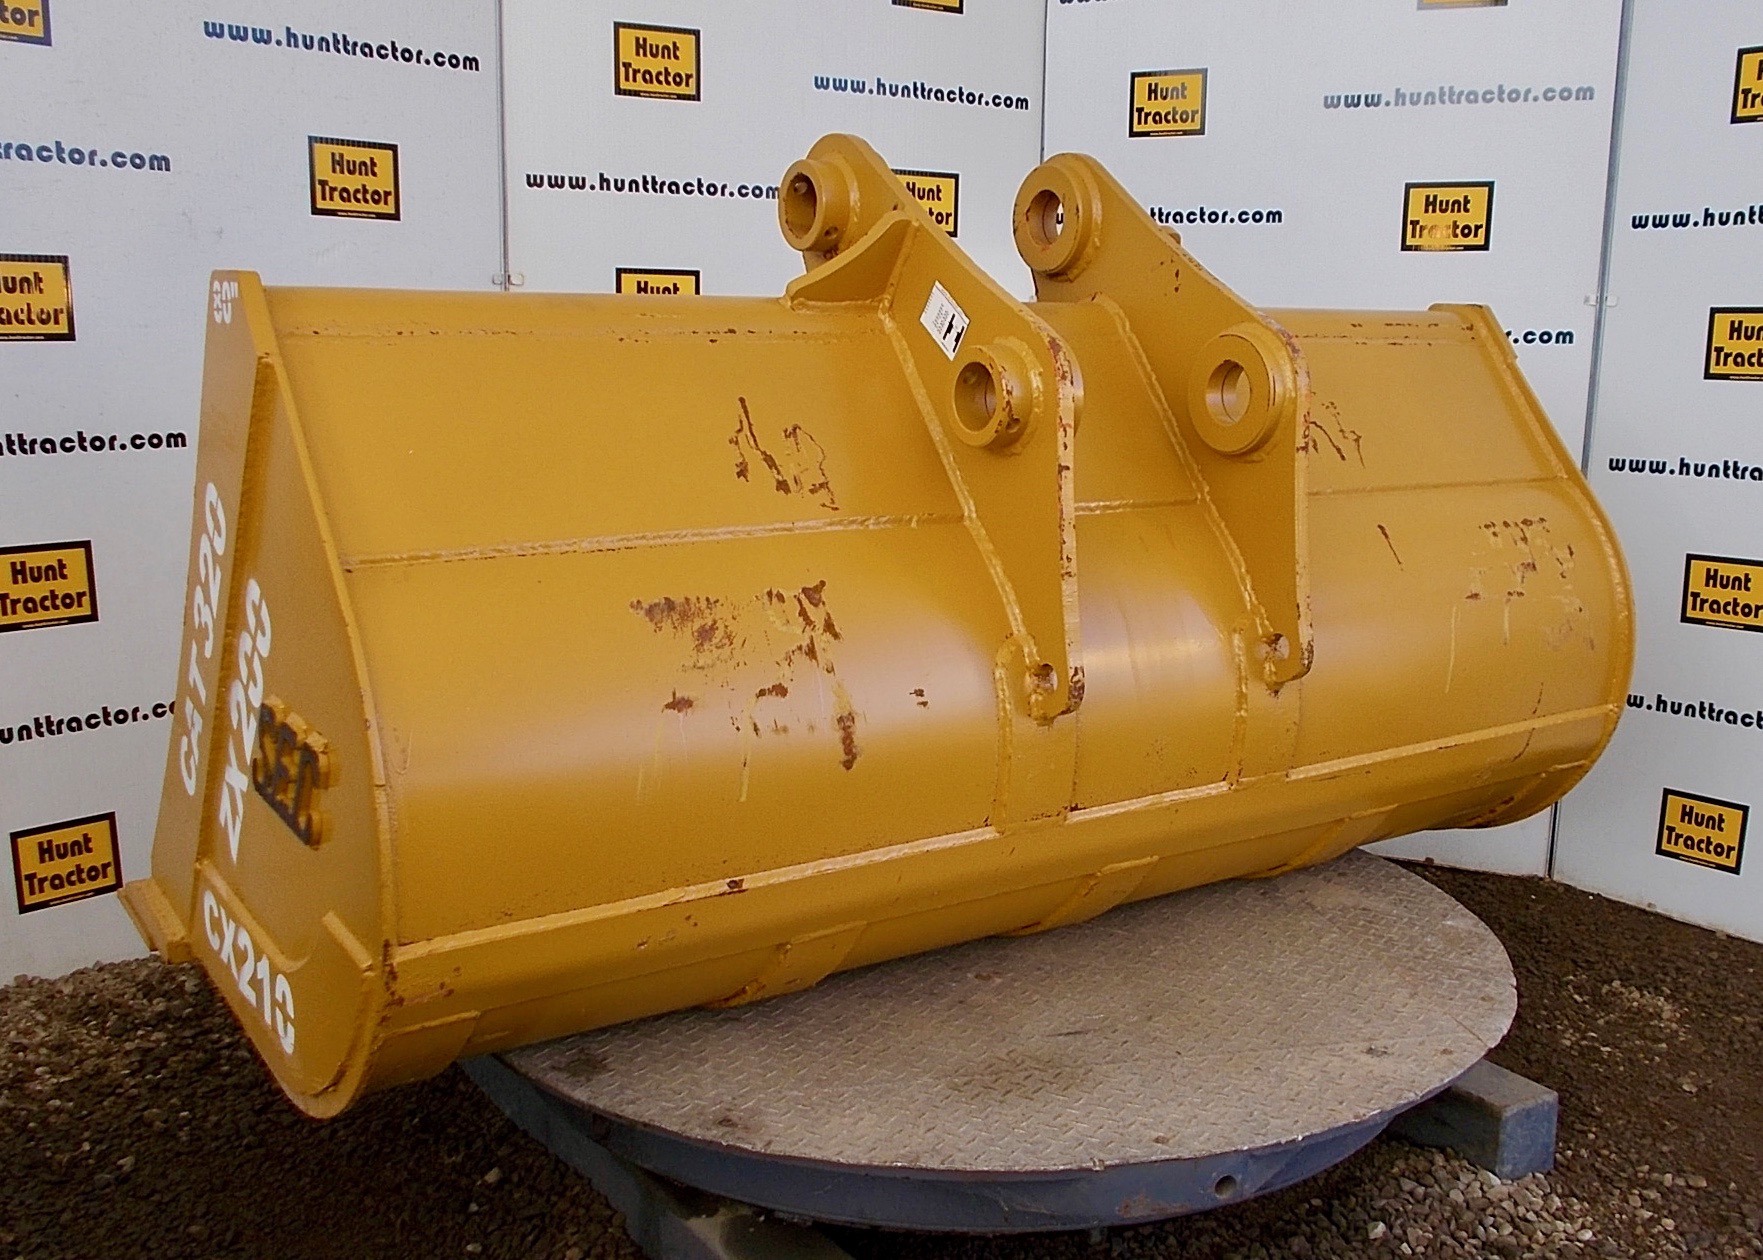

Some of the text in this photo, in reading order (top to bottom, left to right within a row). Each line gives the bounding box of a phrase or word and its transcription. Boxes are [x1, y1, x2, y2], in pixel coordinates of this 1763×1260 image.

[203, 20, 480, 72] www.hunttractor.com
[635, 36, 680, 61] Hunt
[622, 61, 693, 88] Tractor
[814, 75, 1029, 110] www.hunttractor.com
[1147, 82, 1187, 101] Hunt
[1323, 84, 1595, 109] www.hunttractor.com
[1135, 106, 1199, 126] Tractor
[331, 152, 378, 177] Hunt
[318, 179, 392, 206] Tractor
[525, 172, 780, 200] www.hunttractor.com
[1423, 194, 1471, 214] Hunt
[1409, 219, 1483, 239] Tractor
[0, 272, 44, 295] unt
[0, 431, 187, 456] ttractor.com
[1608, 457, 1763, 481] www.hunttra
[10, 558, 68, 585] Hunt
[1704, 567, 1751, 592] Hunt
[0, 589, 87, 617] Tractor
[1690, 591, 1763, 619] Tractor
[1680, 803, 1725, 832] Hunt
[37, 832, 93, 864] Hunt
[1665, 825, 1736, 860] Tractor
[24, 861, 112, 896] Tractor
